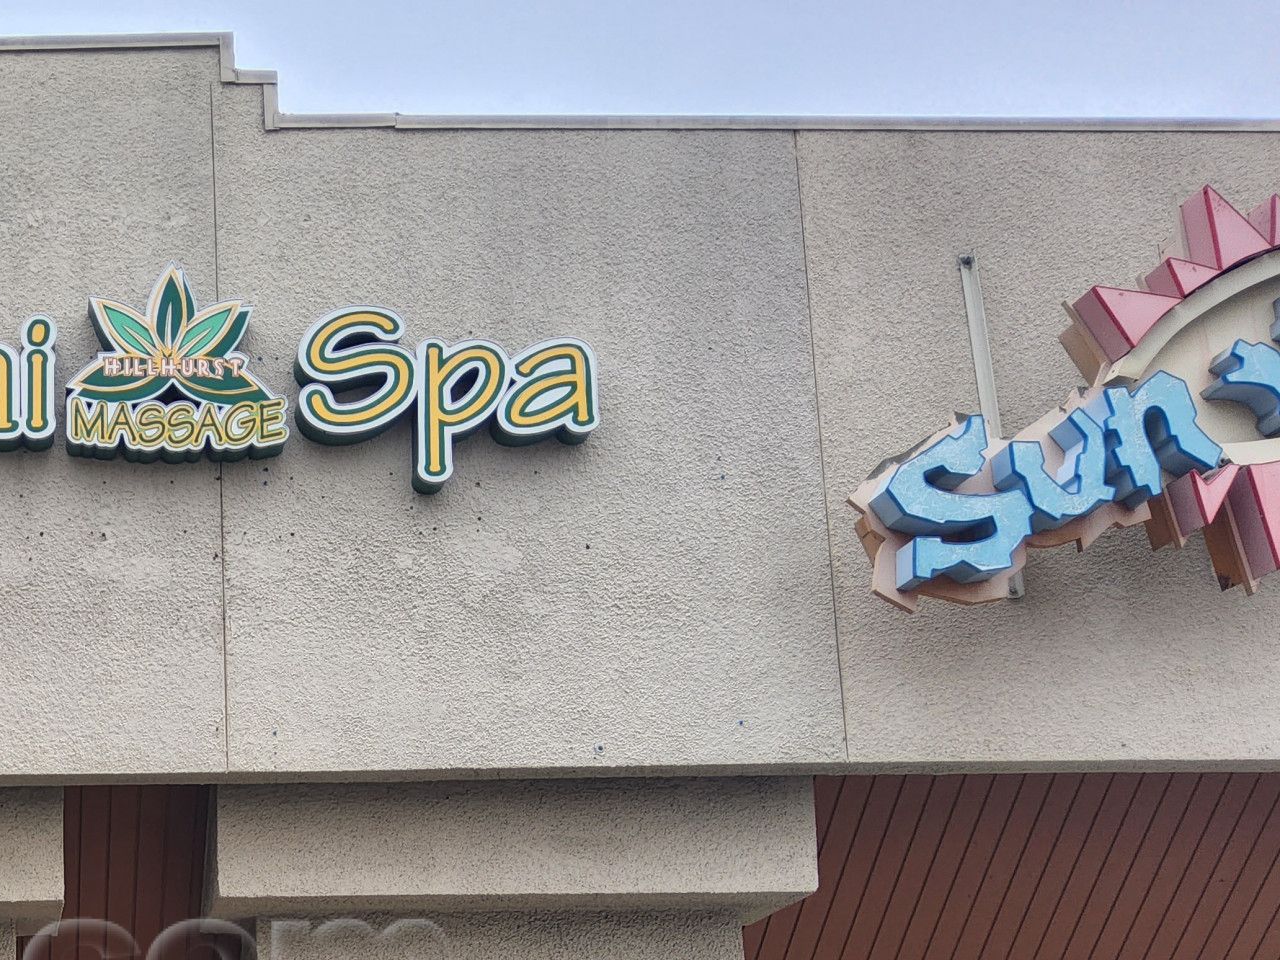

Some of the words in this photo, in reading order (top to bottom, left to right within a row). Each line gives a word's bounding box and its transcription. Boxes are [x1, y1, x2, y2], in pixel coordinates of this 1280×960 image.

[102, 356, 244, 378] HILLHURST
[300, 306, 597, 480] Spa
[70, 397, 287, 446] MASSAGE
